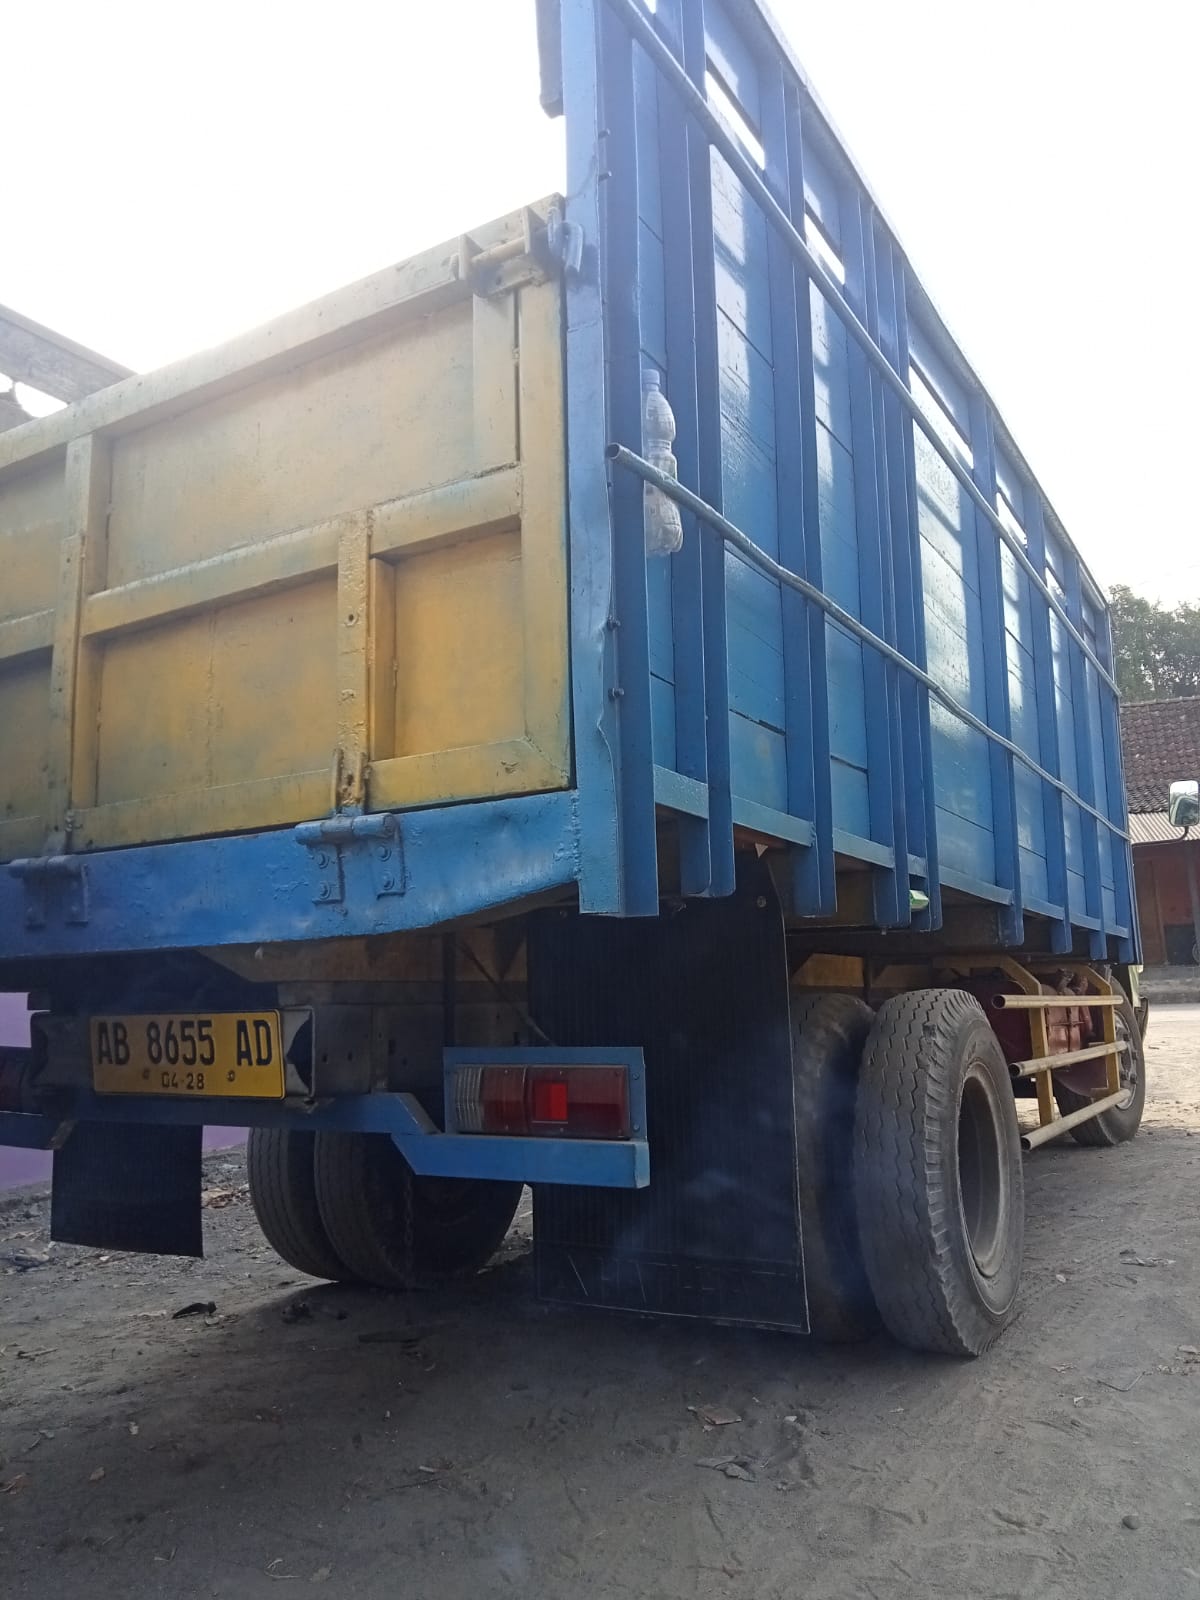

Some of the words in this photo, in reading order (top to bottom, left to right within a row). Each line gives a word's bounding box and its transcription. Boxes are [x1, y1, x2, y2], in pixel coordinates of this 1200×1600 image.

[97, 1022, 131, 1066] AB
[146, 1020, 215, 1066] 8655
[236, 1019, 272, 1066] AD
